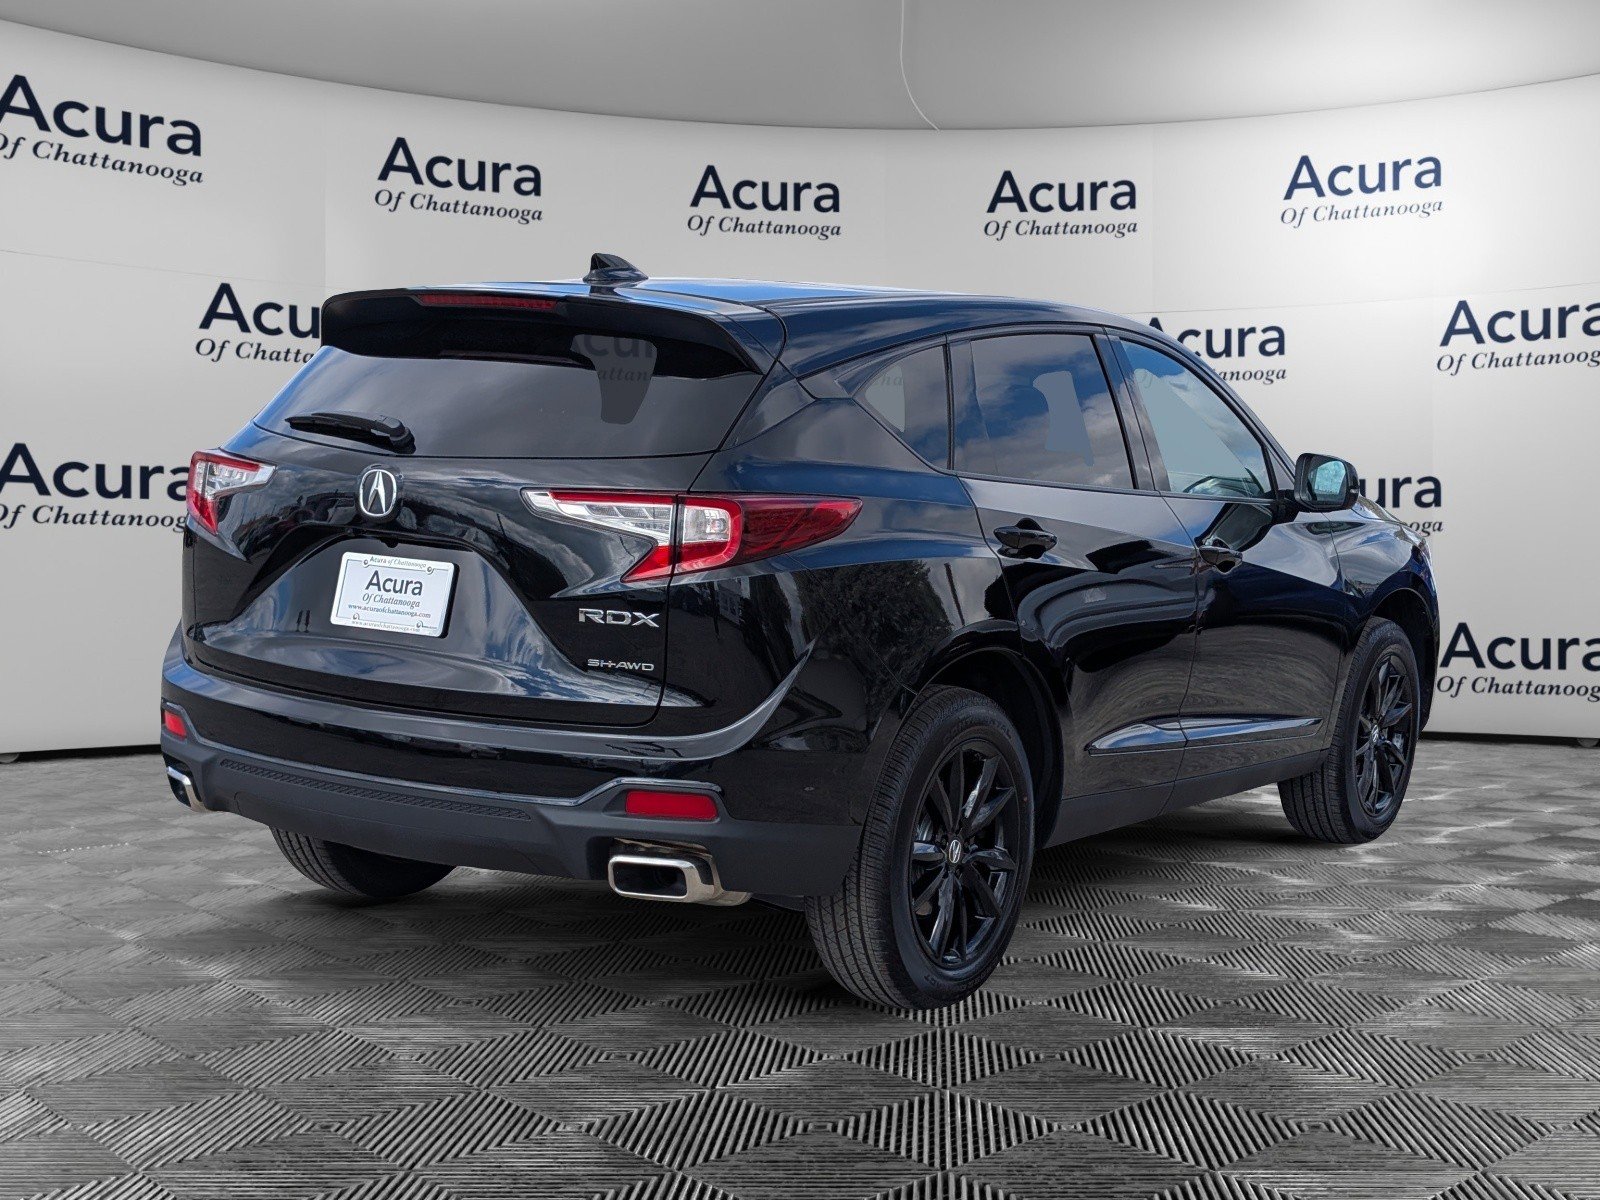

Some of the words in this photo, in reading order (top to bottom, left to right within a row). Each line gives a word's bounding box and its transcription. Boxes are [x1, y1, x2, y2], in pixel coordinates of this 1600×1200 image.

[0, 74, 201, 157] Acura
[32, 140, 203, 187] Chattanooga
[378, 137, 542, 197] Acura
[1283, 154, 1442, 201] Acura
[690, 165, 840, 214] Acura
[987, 170, 1137, 214] Acura
[374, 189, 406, 213] Of
[410, 192, 543, 225] Chattanooga
[1280, 207, 1309, 228] Of
[1313, 201, 1443, 223] Chattanooga
[687, 215, 715, 237] Of
[718, 216, 841, 241] Chattanooga
[983, 220, 1012, 242] Of
[1015, 219, 1138, 238] Chattanooga
[199, 283, 320, 339] Acu
[1440, 300, 1600, 347] Acura
[195, 338, 231, 363] Of
[235, 341, 314, 364] Chatta
[1436, 353, 1467, 377] Of
[1471, 350, 1600, 370] Chattanoog
[1218, 368, 1287, 386] anooga
[0, 443, 190, 502] Acura
[1359, 476, 1442, 509] ura
[32, 504, 188, 533] Chattanoog
[365, 570, 423, 596] Acura
[362, 592, 373, 605] Of
[373, 594, 421, 609] Chattanooga
[578, 608, 660, 628] RDX
[1440, 622, 1600, 672] Acura
[587, 658, 655, 671] SH-AWD
[1436, 675, 1467, 699] Of
[1471, 676, 1600, 703] Chattanoog
